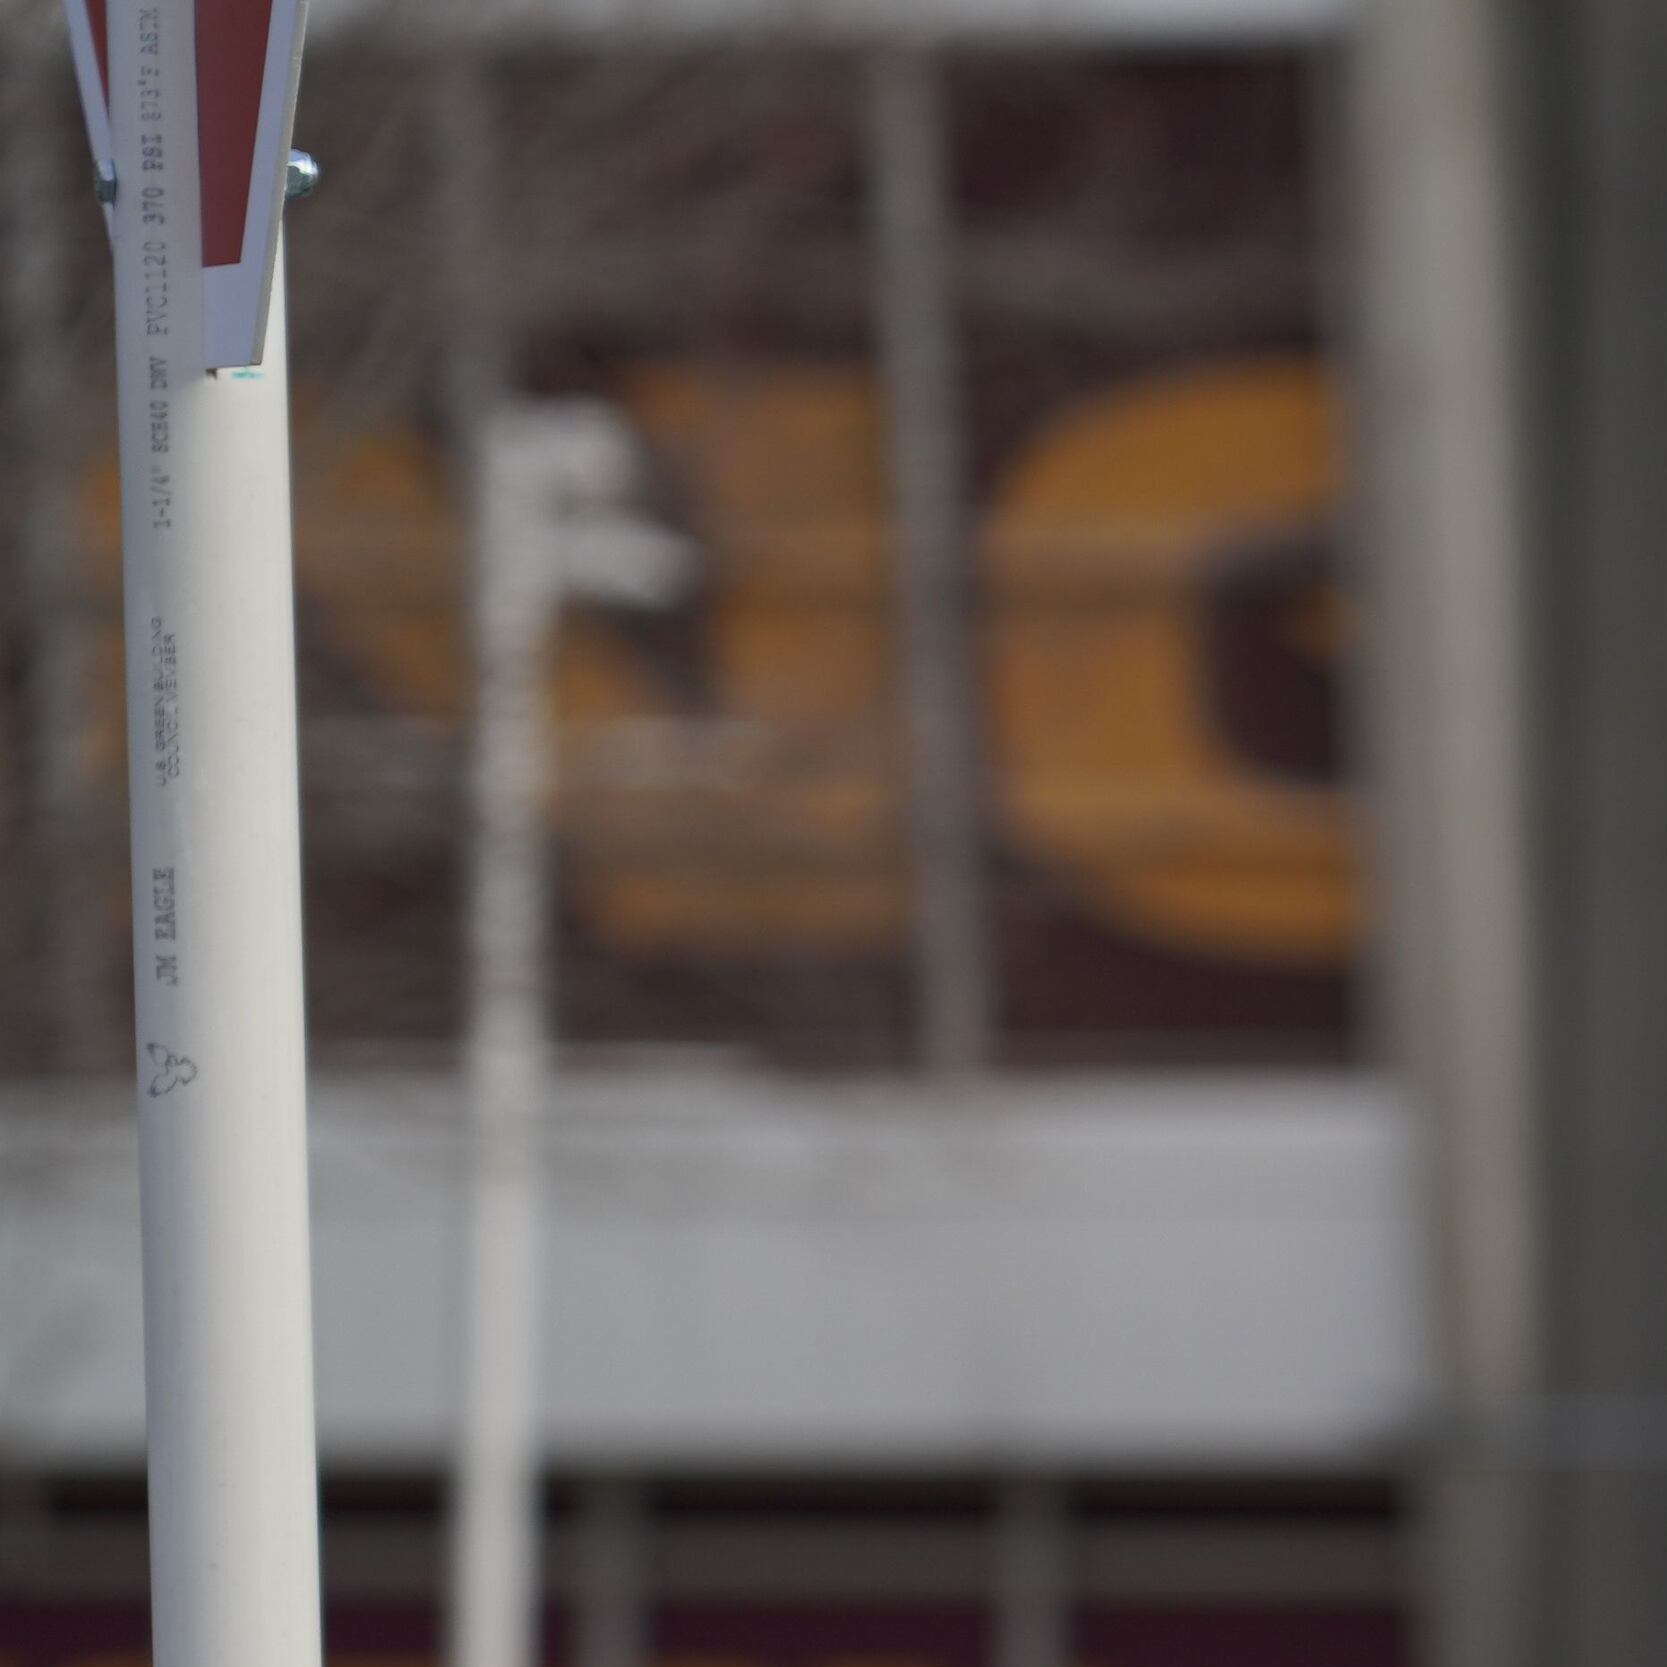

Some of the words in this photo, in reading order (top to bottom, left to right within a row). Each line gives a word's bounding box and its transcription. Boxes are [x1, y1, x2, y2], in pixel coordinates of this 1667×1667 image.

[142, 134, 164, 172] PSI
[142, 188, 165, 225] 370
[144, 240, 169, 337] PVC1120
[152, 695, 168, 752] GREEN
[152, 866, 178, 942] EAGLE
[155, 953, 179, 988] JM
